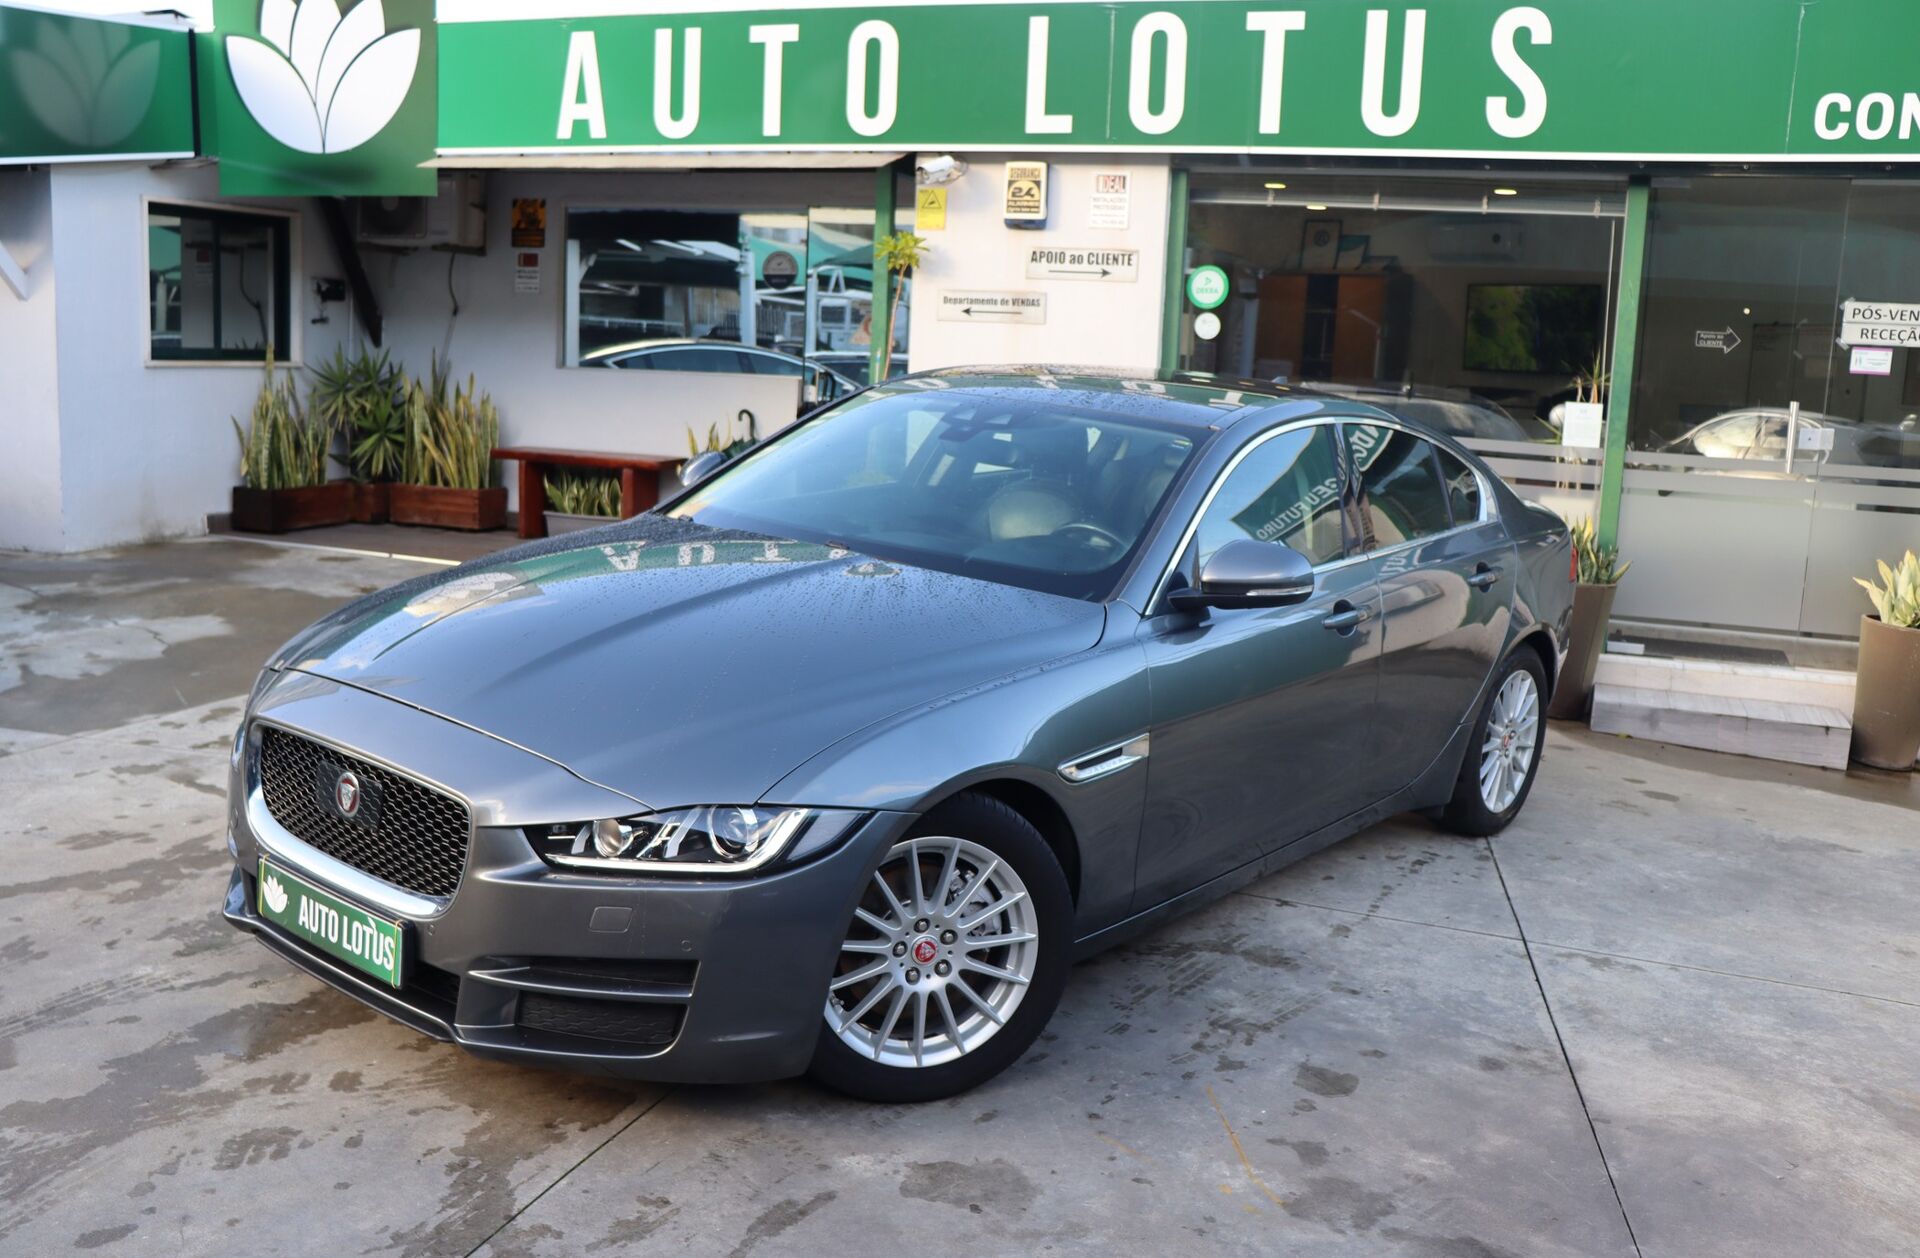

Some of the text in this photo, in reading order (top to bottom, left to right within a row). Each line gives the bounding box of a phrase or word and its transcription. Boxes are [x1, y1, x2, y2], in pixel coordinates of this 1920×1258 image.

[556, 6, 1553, 139] AUTO LOTUS
[1011, 186, 1036, 198] 24
[1030, 250, 1134, 267] APOIO ao CLIENTE
[943, 295, 1041, 308] Departamento de VENDAS
[1860, 326, 1920, 344] RECEÇÃ
[298, 894, 395, 971] AUTO LOTUS
